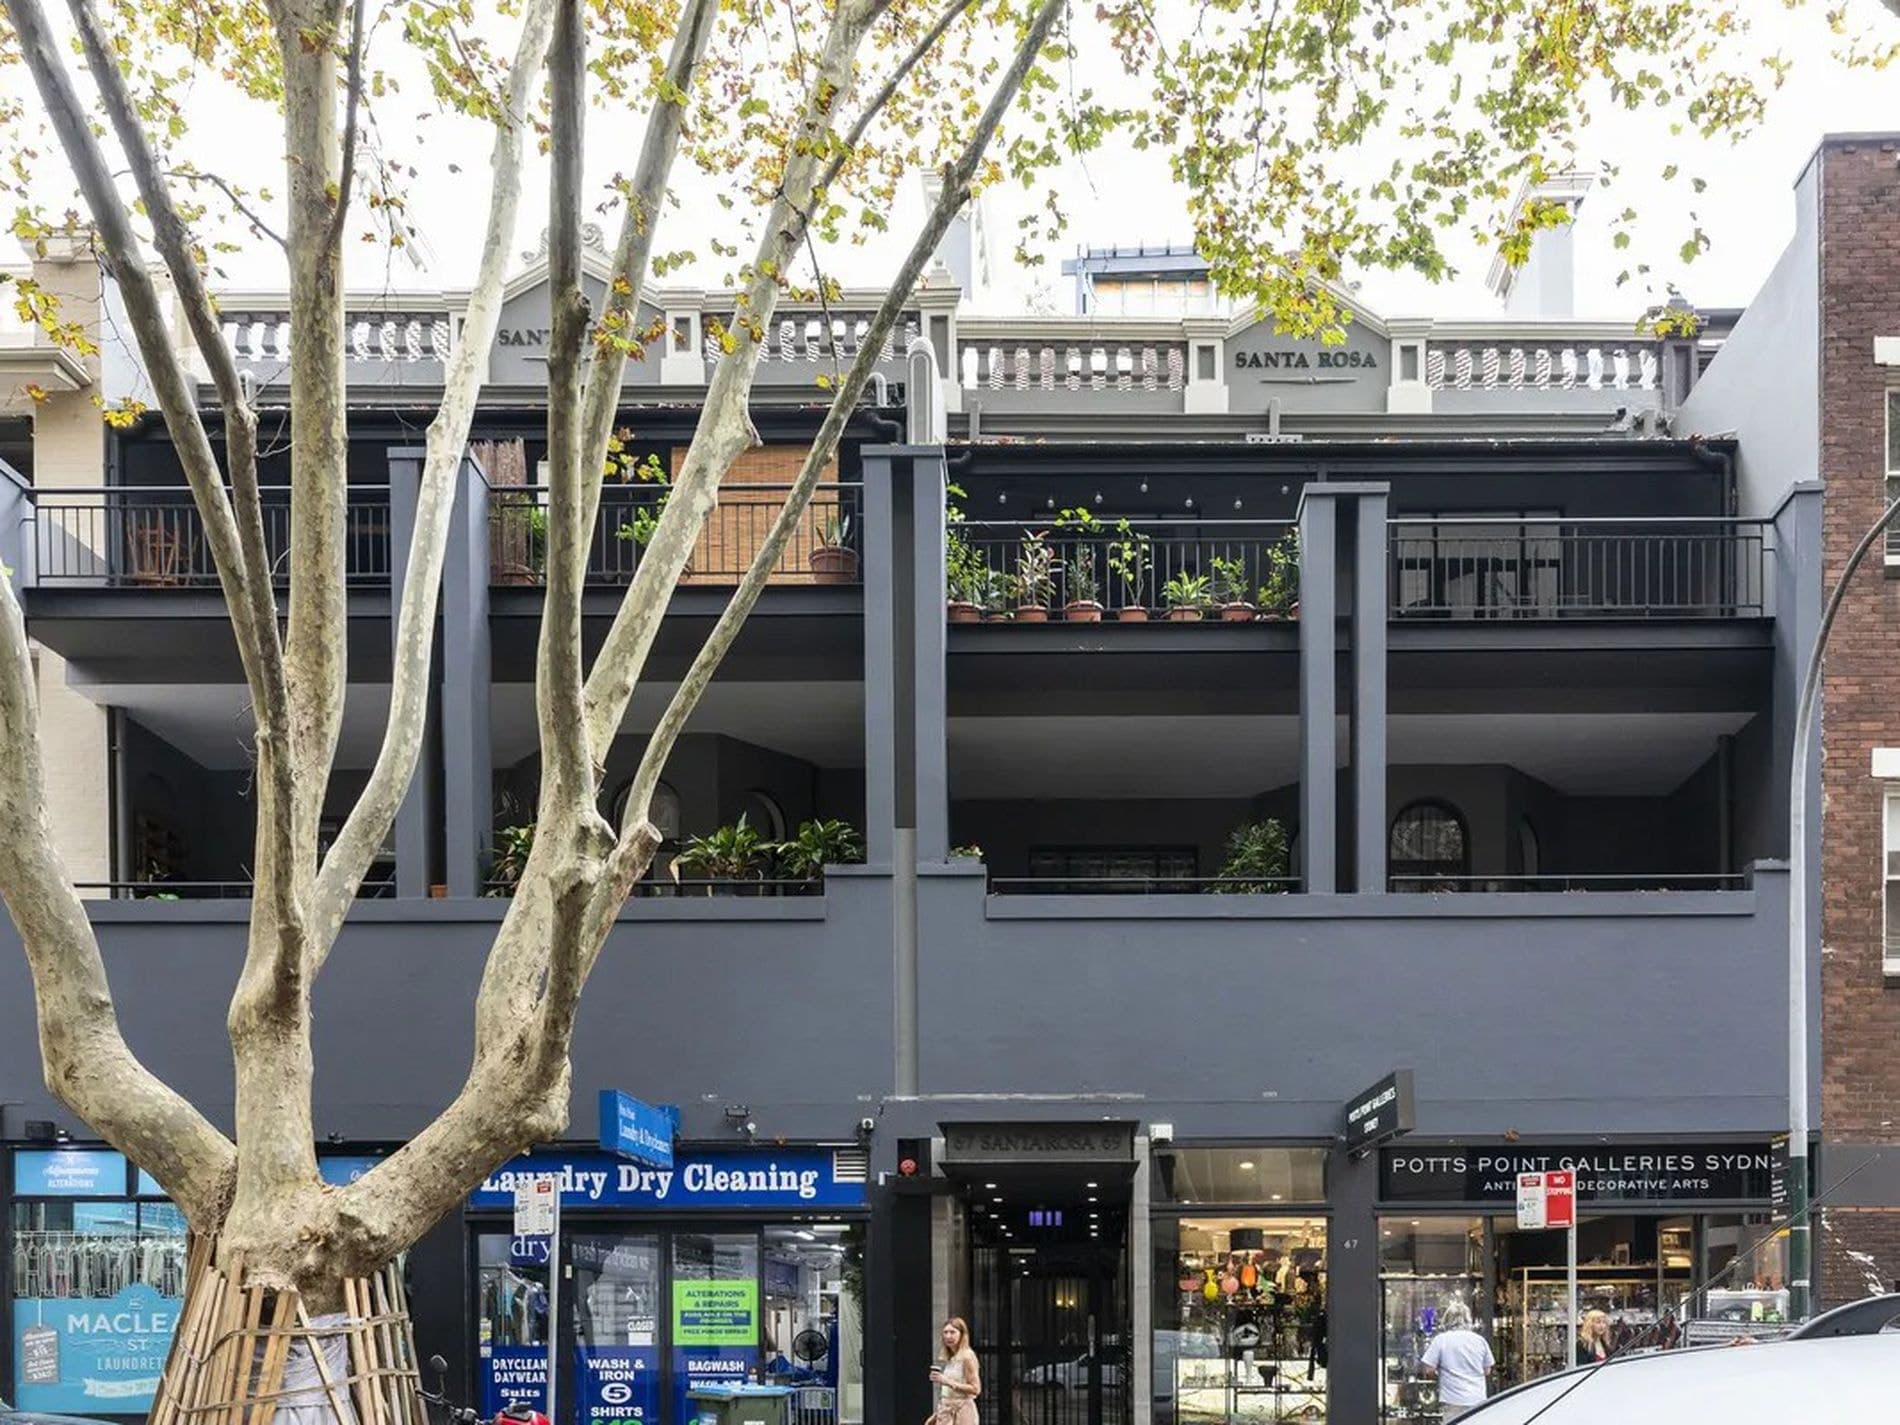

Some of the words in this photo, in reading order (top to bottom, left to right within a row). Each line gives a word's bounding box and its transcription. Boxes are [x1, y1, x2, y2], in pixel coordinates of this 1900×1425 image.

[498, 329, 550, 346] SAN
[1235, 352, 1309, 368] SANTA
[1318, 352, 1377, 368] ROSA
[1392, 1157, 1467, 1174] POTTS
[1478, 1156, 1550, 1172] POINT
[1559, 1155, 1695, 1173] GALLERIES
[617, 1164, 674, 1199] Dry
[683, 1162, 819, 1199] Cleaning
[1577, 1180, 1667, 1191] DECORATIVE
[1672, 1179, 1710, 1190] ARTS
[511, 1233, 551, 1263] dry
[1343, 1239, 1359, 1249] 67
[686, 1290, 746, 1298] ALTERATIONS
[627, 1320, 654, 1332] CLOSED
[127, 1339, 148, 1351] ST
[493, 1359, 548, 1370] DRYCLEAN
[588, 1359, 629, 1369] WASH
[634, 1359, 645, 1369] &
[688, 1360, 745, 1372] BAGWASH
[494, 1372, 546, 1383] DAYWEAR
[599, 1371, 634, 1381] IRON
[500, 1388, 540, 1397] Suits
[590, 1406, 643, 1417] SHIRTS
